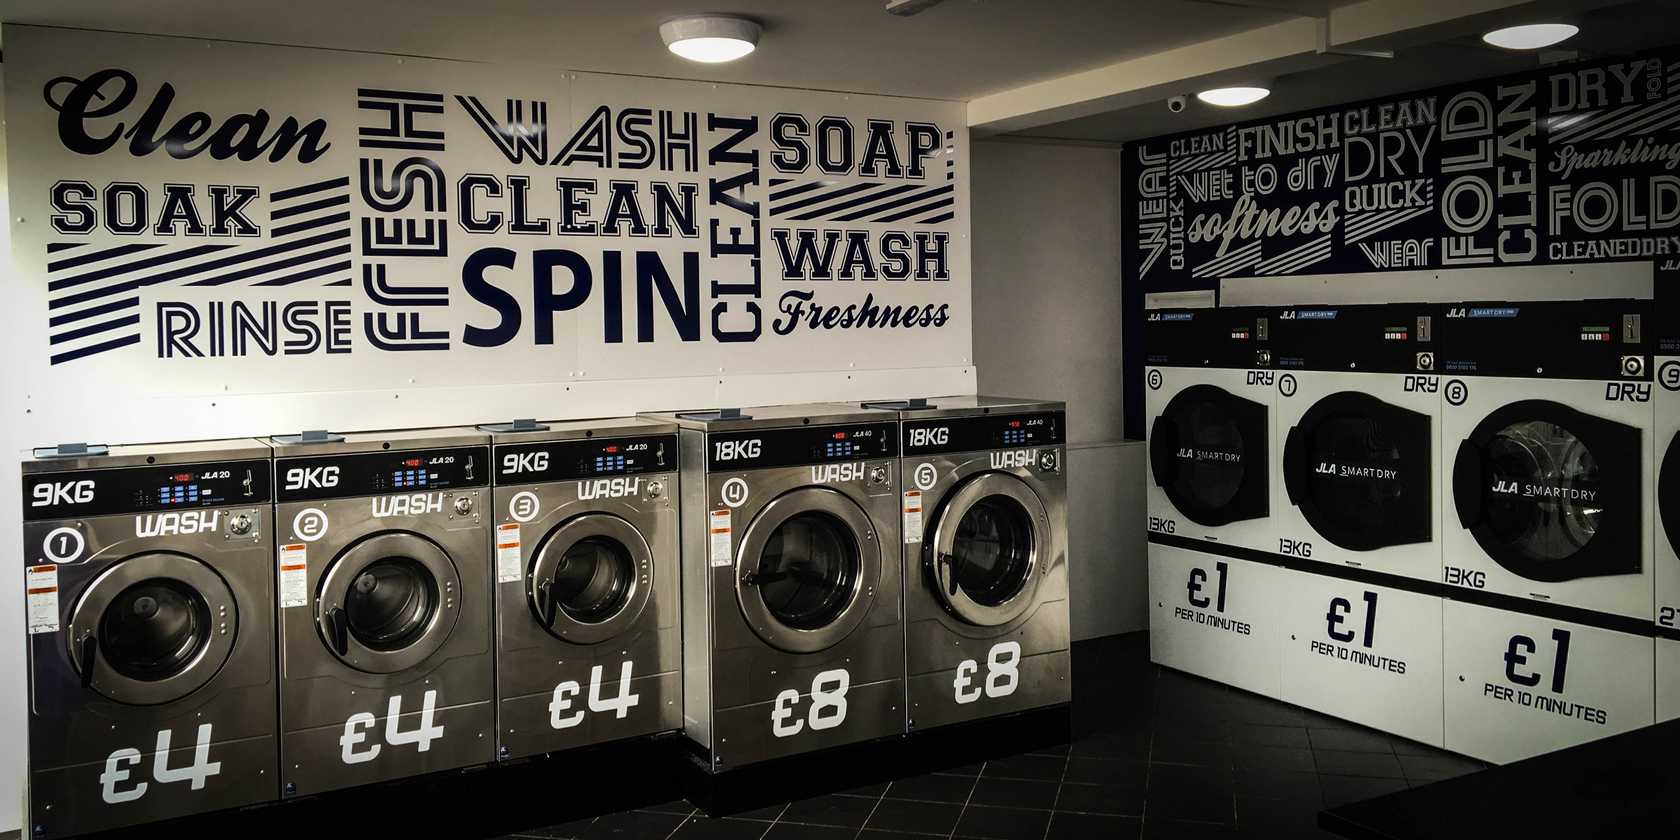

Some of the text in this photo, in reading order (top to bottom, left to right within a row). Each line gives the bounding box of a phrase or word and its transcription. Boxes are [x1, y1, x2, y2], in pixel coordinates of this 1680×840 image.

[1549, 59, 1647, 113] DRY
[44, 69, 331, 163] Clean
[455, 95, 698, 172] WASH
[1344, 96, 1438, 135] CLEAN
[769, 112, 943, 180] SOAP
[1170, 132, 1225, 157] CLEAN
[1238, 112, 1340, 161] FINISH
[1344, 125, 1437, 182] DRY
[1441, 91, 1494, 265] FOLD
[1497, 80, 1538, 263] CLEAN
[1548, 137, 1680, 180] Sparkling
[1242, 163, 1278, 197] to
[1344, 178, 1426, 212] QUICK
[49, 179, 262, 238] SOAK
[457, 173, 699, 238] CLEAN
[1549, 175, 1680, 236] FOLD
[708, 113, 762, 343] CLEAN
[1169, 199, 1185, 270] QUICK
[1188, 193, 1340, 258] softness
[771, 228, 949, 281] WASH
[461, 247, 701, 347] SPIN
[773, 290, 949, 336] Freshness
[1280, 310, 1296, 320] JLA
[1445, 307, 1466, 318] JLA
[156, 300, 352, 358] RINSE
[1247, 371, 1275, 386] DRY
[1404, 376, 1439, 393] DRY
[1605, 382, 1651, 402] DRY
[715, 439, 761, 461] 18KG
[909, 427, 949, 447] 18KG
[1176, 447, 1193, 459] JLA
[201, 470, 230, 479] JLA 20
[285, 466, 340, 490] 9KG
[502, 451, 549, 474] 9KG
[811, 462, 865, 484] WASH
[990, 449, 1036, 470] WASH
[1315, 462, 1336, 475] JLA
[32, 480, 95, 507] 9KG
[372, 492, 443, 518] WASH
[577, 477, 639, 500] WASH
[1491, 480, 1519, 495] JLA
[135, 510, 219, 538] WASH
[1148, 516, 1176, 534] 13KG
[1278, 538, 1313, 557] 13KG
[1187, 561, 1228, 613] £1
[1444, 566, 1487, 589] 13KG
[1175, 605, 1251, 636] PER 10 MINUTES
[1326, 590, 1378, 649] £1
[1659, 605, 1680, 627] 2
[954, 641, 1021, 705] £8
[1311, 640, 1407, 675] PER 10 MINUTES
[1504, 627, 1571, 694] £1
[549, 660, 639, 731] £4
[771, 667, 850, 738] £8
[1484, 682, 1608, 725] PER 10 MINUTES
[339, 689, 445, 765] £4
[99, 722, 222, 804] £4
